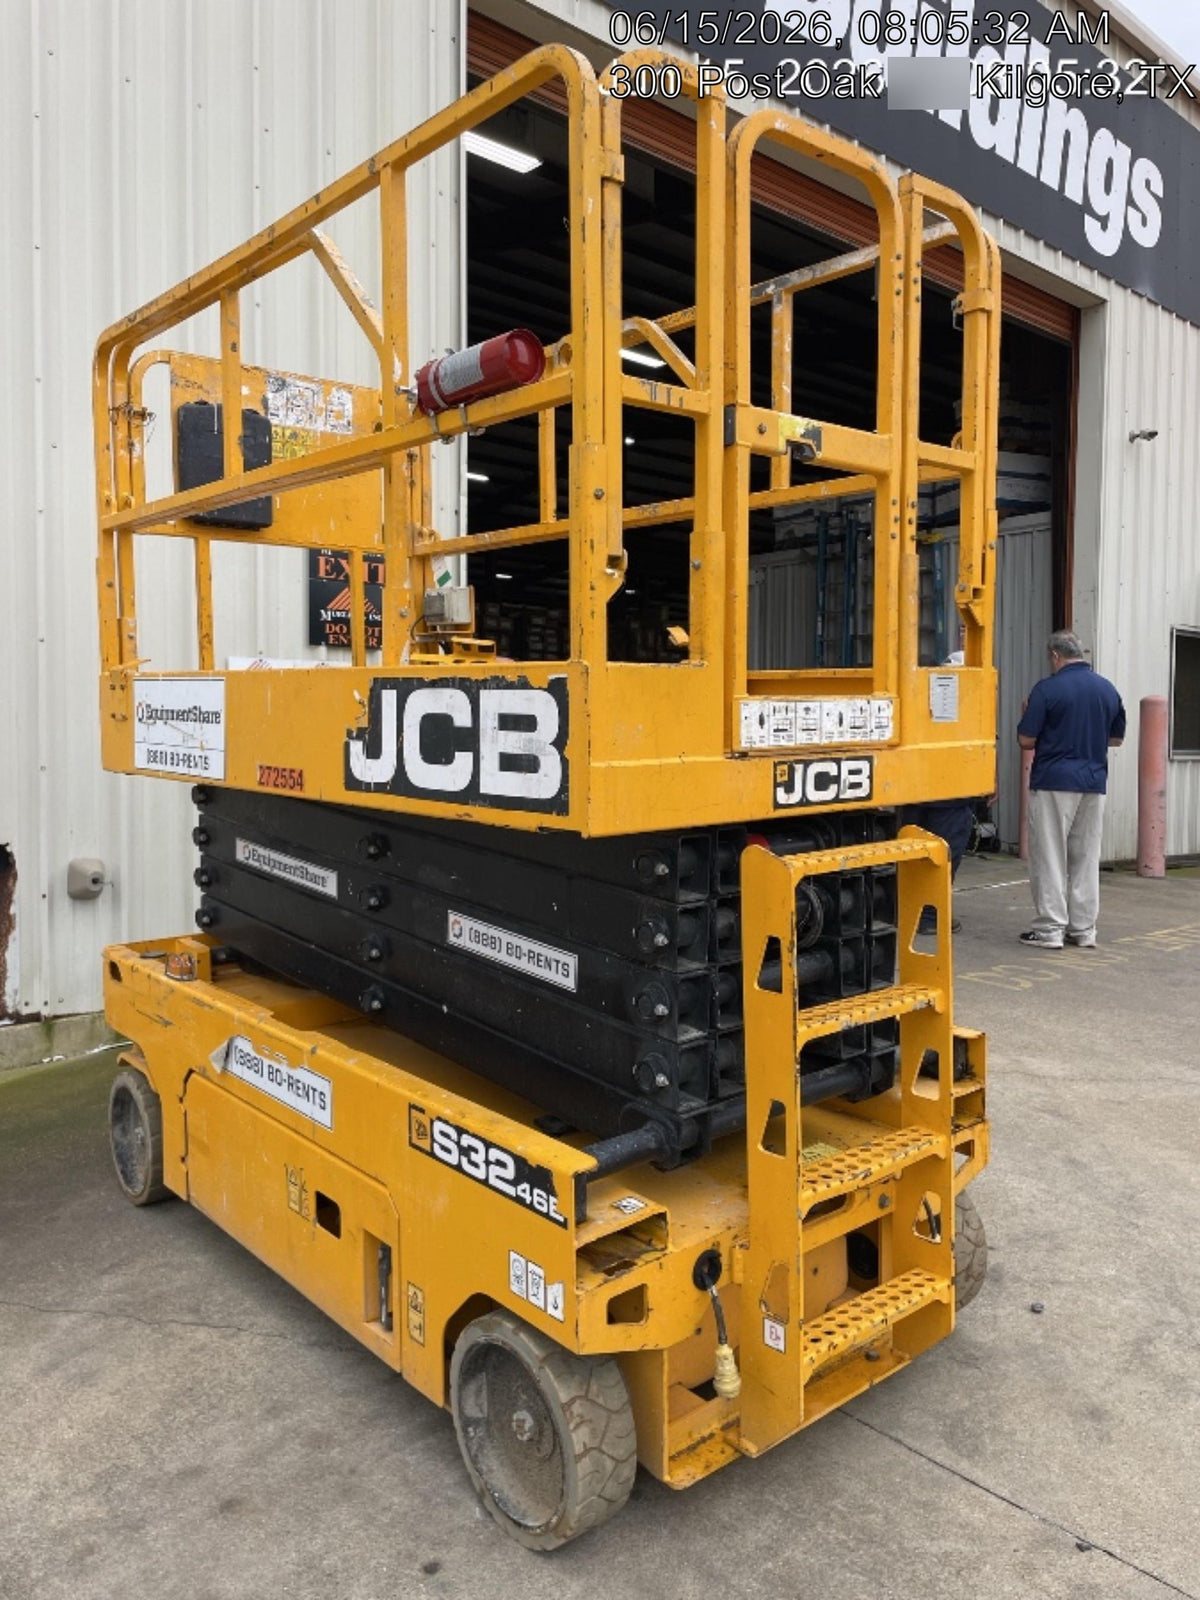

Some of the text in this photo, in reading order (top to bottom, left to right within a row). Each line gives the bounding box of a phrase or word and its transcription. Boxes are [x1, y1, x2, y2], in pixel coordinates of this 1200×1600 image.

[325, 622, 347, 634] DO
[328, 634, 378, 648] ENR
[145, 703, 221, 725] EquipmentShare
[349, 687, 562, 800] JCB
[258, 765, 304, 792] 272554
[776, 759, 871, 805] JCB
[468, 926, 502, 954] (888)
[234, 1045, 264, 1079] (888)
